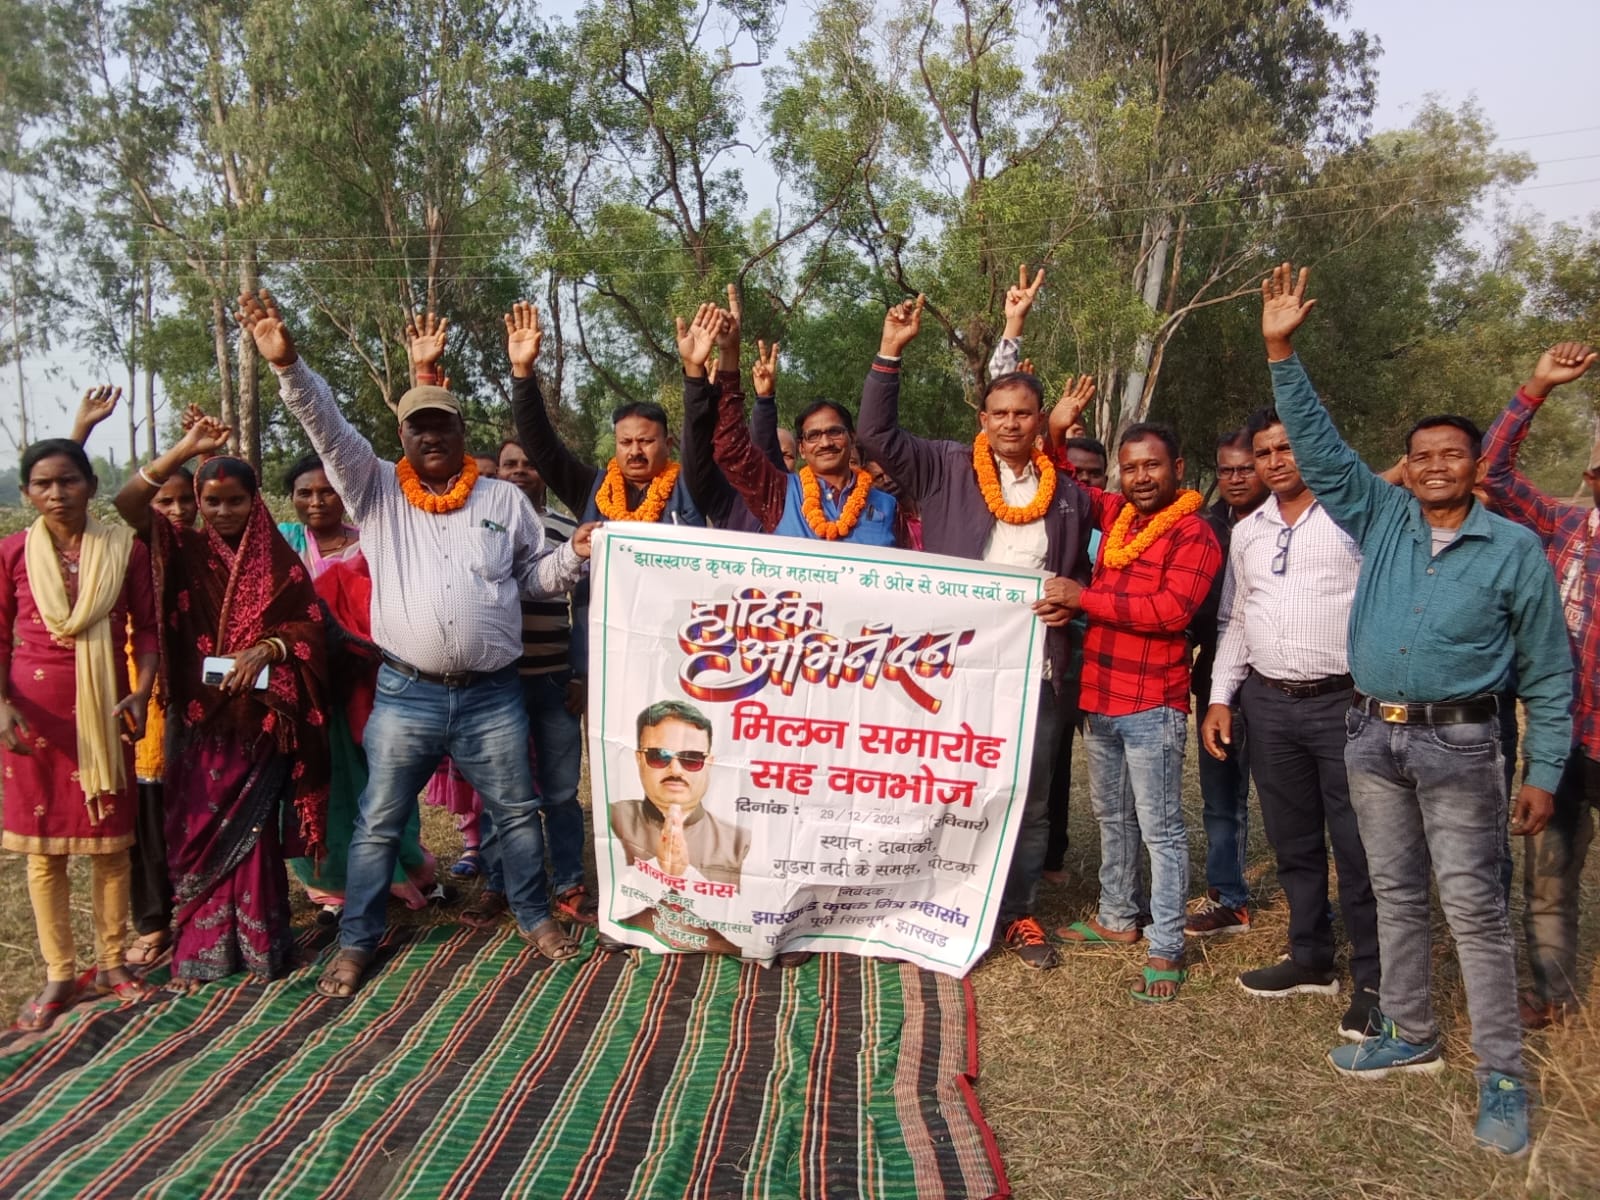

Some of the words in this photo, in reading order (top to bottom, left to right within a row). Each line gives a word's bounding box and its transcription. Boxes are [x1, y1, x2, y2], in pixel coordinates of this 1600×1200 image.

[706, 558, 747, 578] कृषक
[751, 557, 783, 579] मित्र
[859, 569, 880, 588] की
[884, 571, 915, 592] ओर
[918, 574, 932, 594] से
[936, 580, 968, 598] आप
[972, 581, 1002, 602] सबों
[1005, 587, 1027, 604] का
[731, 700, 850, 750] मिलन
[858, 722, 1007, 769] समारोह
[750, 760, 818, 795] सह
[828, 764, 978, 808] वनभोज
[735, 797, 789, 815] दिनांक
[820, 834, 863, 852] स्थान
[819, 857, 851, 878] नदी
[854, 859, 871, 877] के
[692, 881, 736, 899] दास
[823, 902, 871, 914] कृषक
[909, 901, 969, 928] महासंघ
[896, 918, 949, 948] झारखंड
